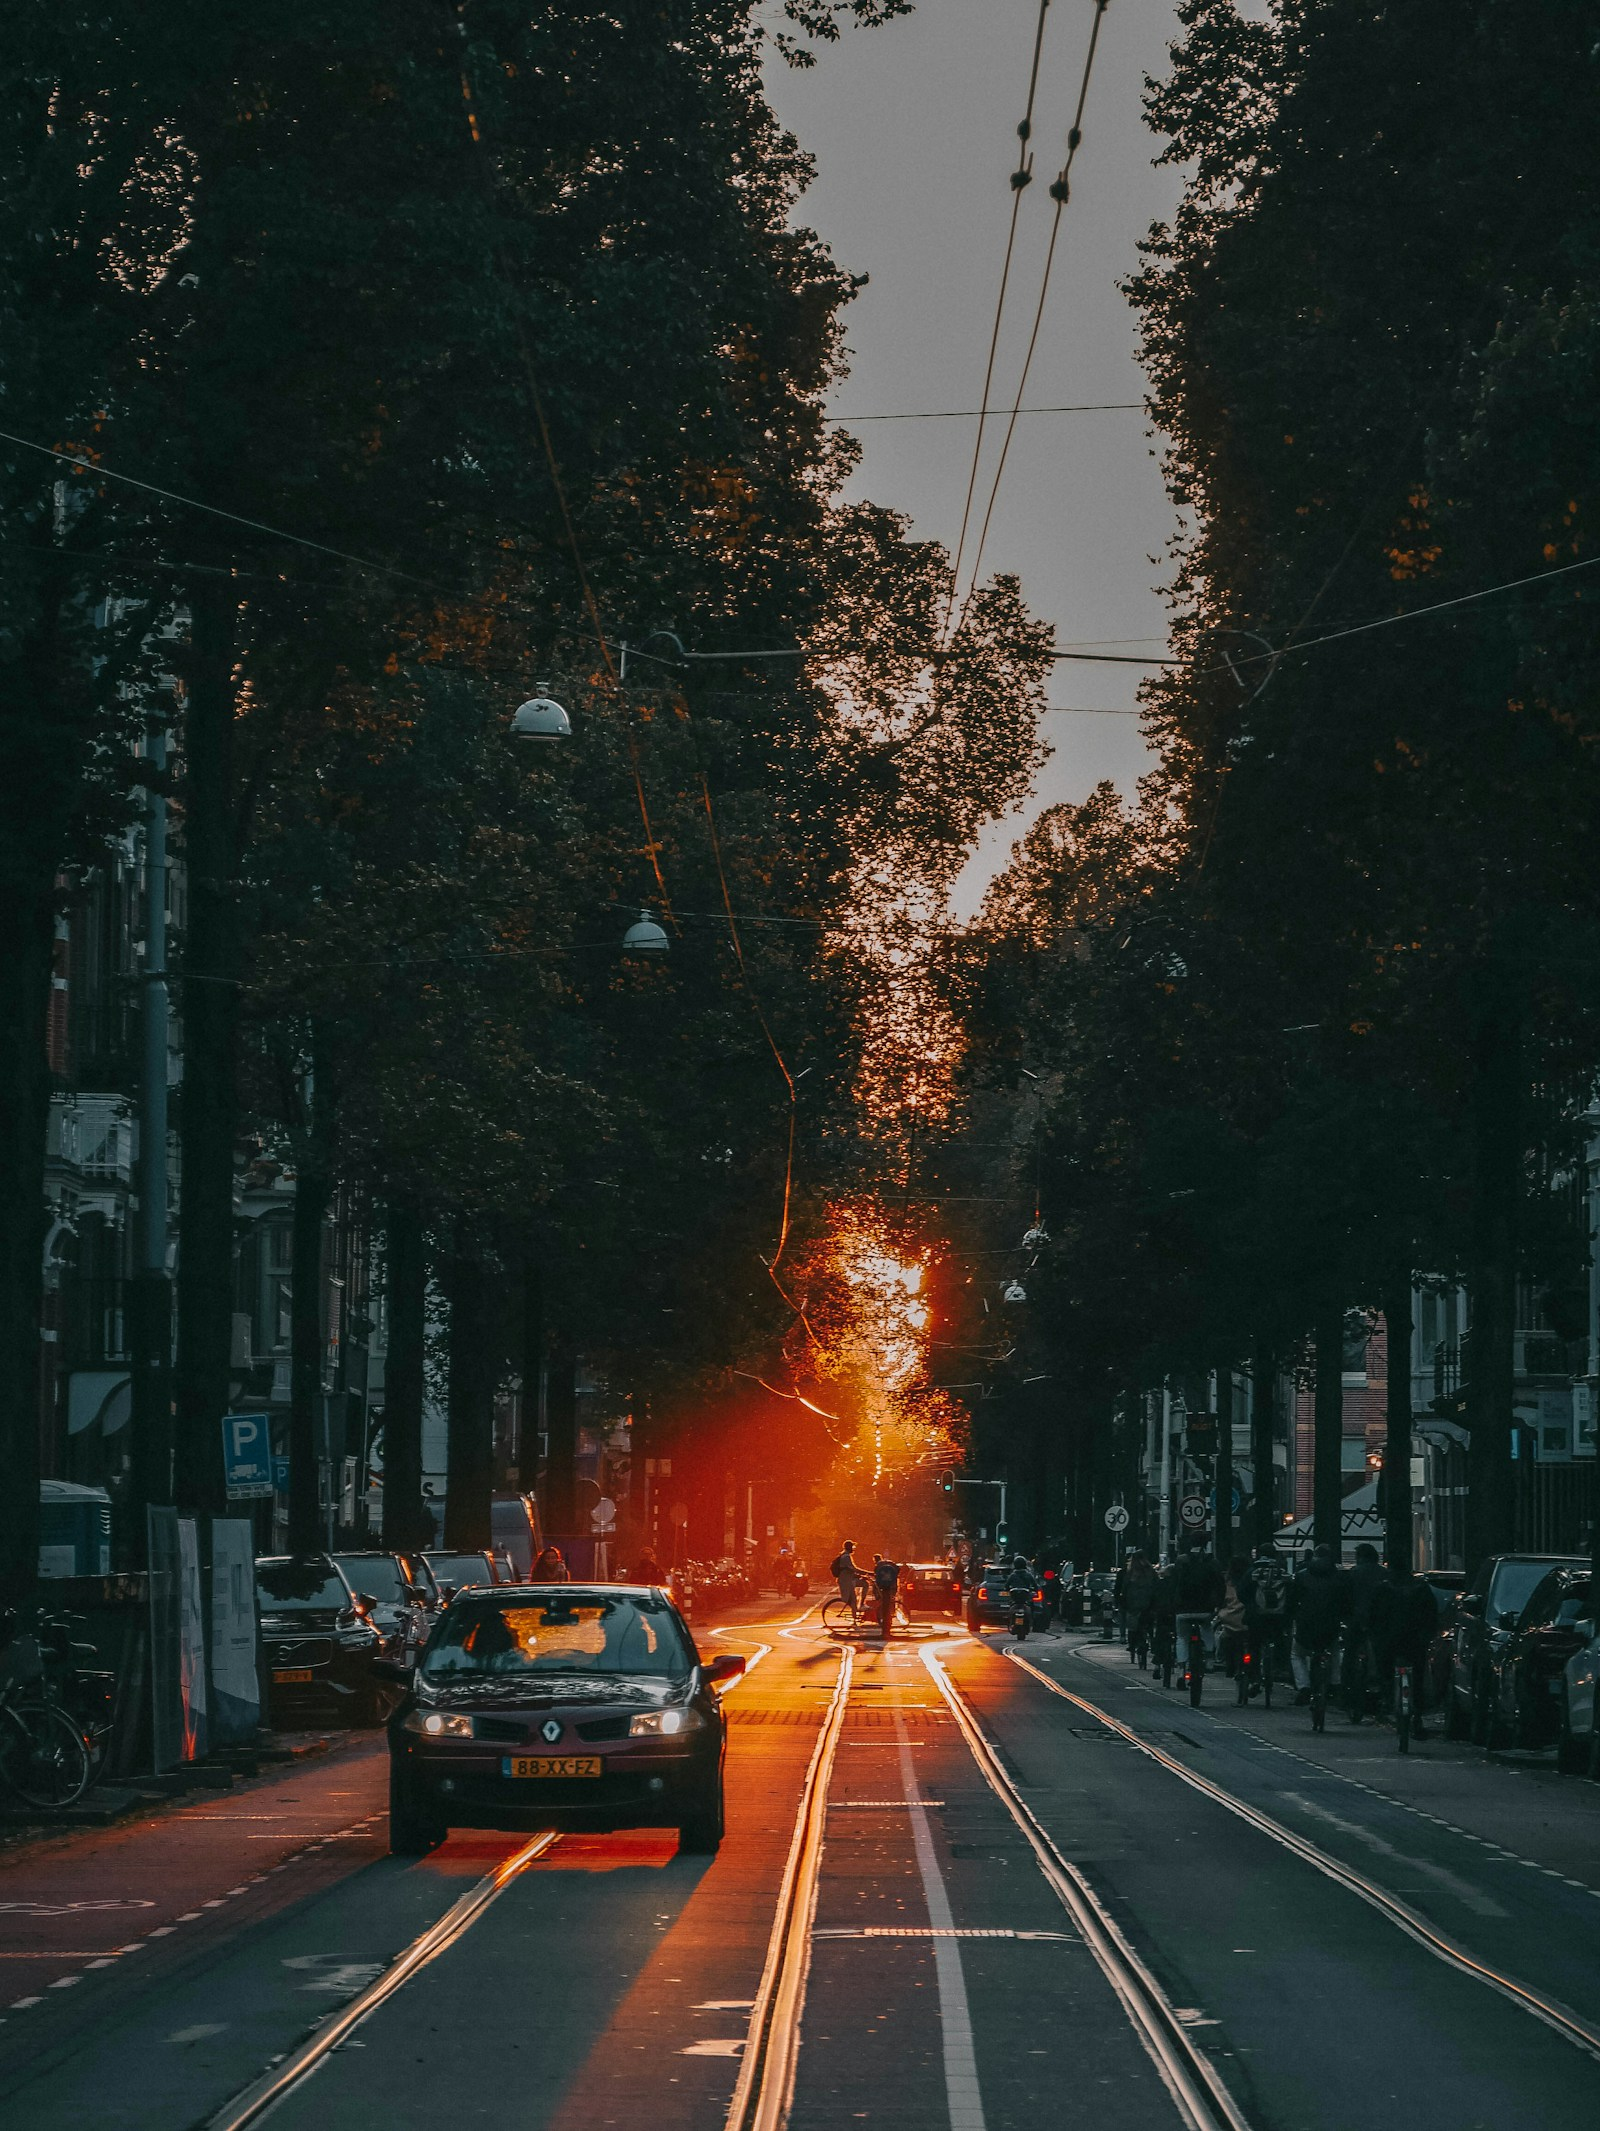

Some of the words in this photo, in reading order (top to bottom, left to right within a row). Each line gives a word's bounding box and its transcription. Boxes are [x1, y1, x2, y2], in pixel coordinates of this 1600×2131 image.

[232, 1421, 258, 1457] P
[277, 1466, 287, 1484] P
[1107, 1512, 1127, 1525] 30
[1184, 1505, 1204, 1517] 30
[518, 1760, 595, 1775] 88-XX-FZ
